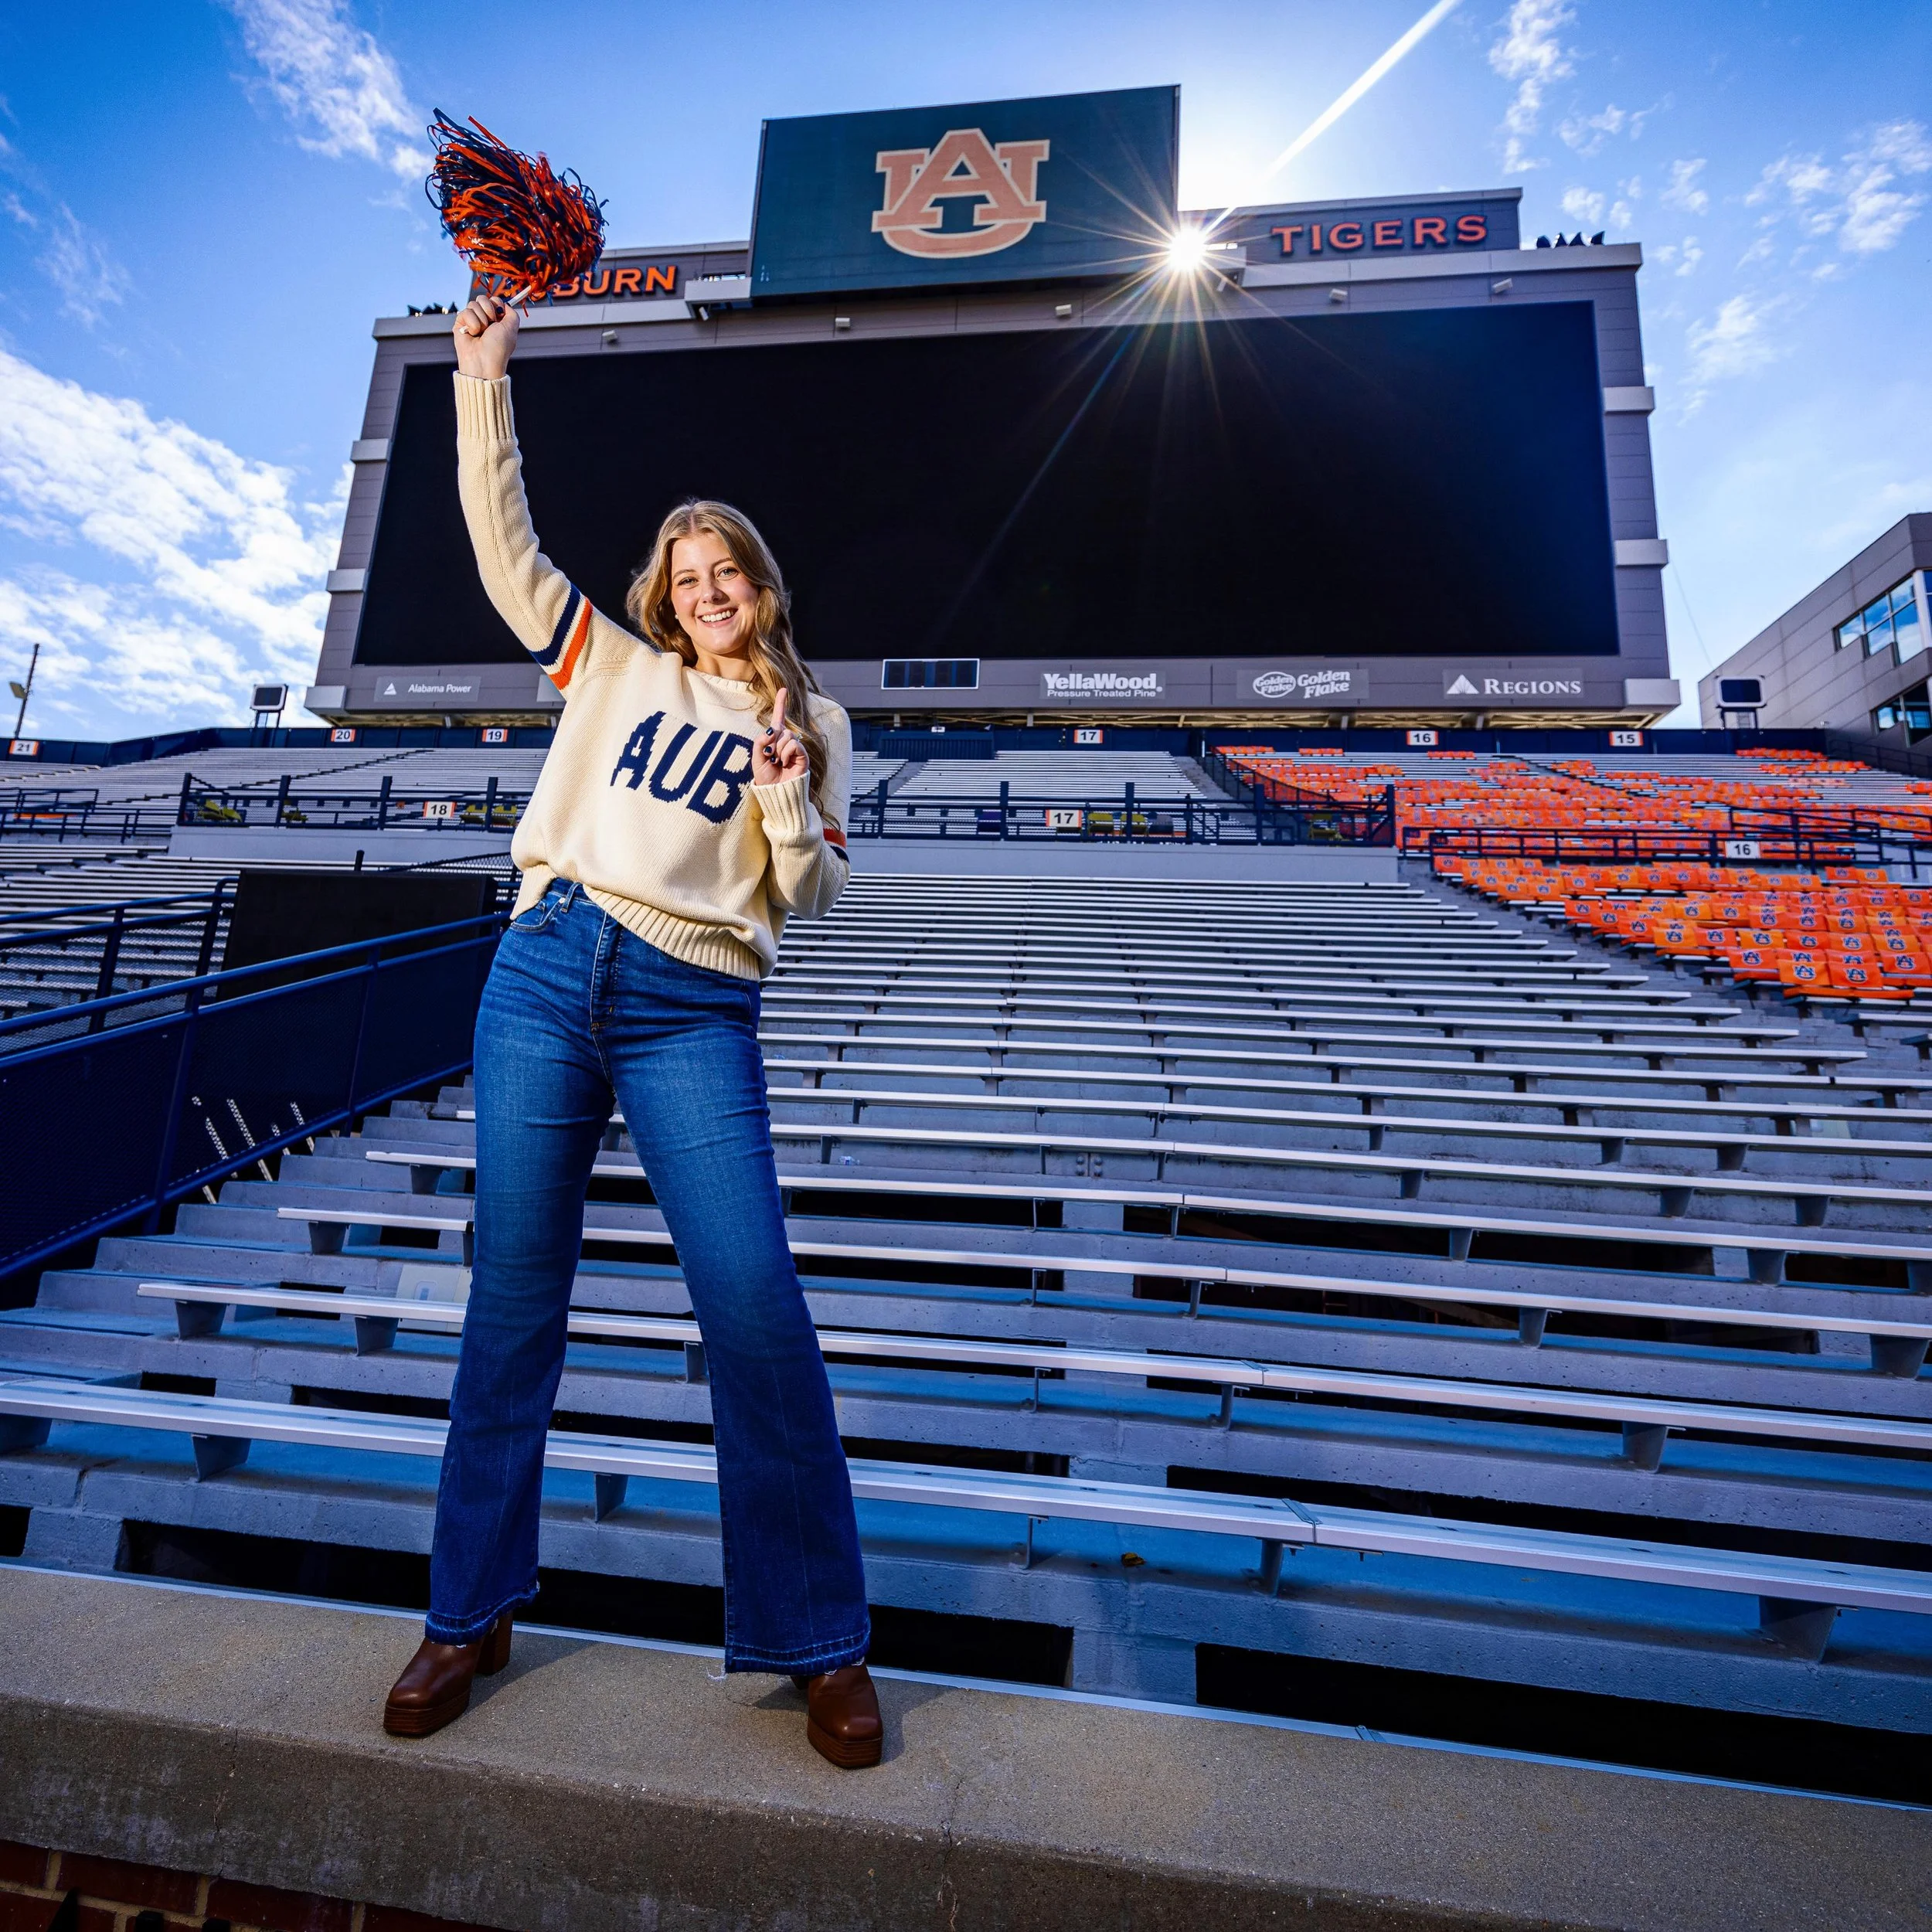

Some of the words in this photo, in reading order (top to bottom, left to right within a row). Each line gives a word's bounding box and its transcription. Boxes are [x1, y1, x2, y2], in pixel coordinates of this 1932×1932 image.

[1271, 216, 1488, 253] TIGERS
[1257, 675, 1294, 687] Golden
[1298, 670, 1351, 687] Golden
[408, 683, 445, 693] Alabama
[446, 683, 472, 693] Power
[1260, 683, 1293, 694] Flake
[1304, 682, 1350, 699] Flake
[1484, 679, 1582, 695] REGIONS
[335, 730, 351, 740] 20
[488, 730, 502, 740] 19
[1080, 731, 1097, 741] 17
[1414, 733, 1431, 743] 16
[1617, 733, 1635, 743] 15
[17, 743, 30, 752] 21
[610, 710, 754, 825] AUB
[430, 804, 447, 815] 18
[1053, 812, 1074, 824] 17
[1734, 844, 1751, 855] 16
